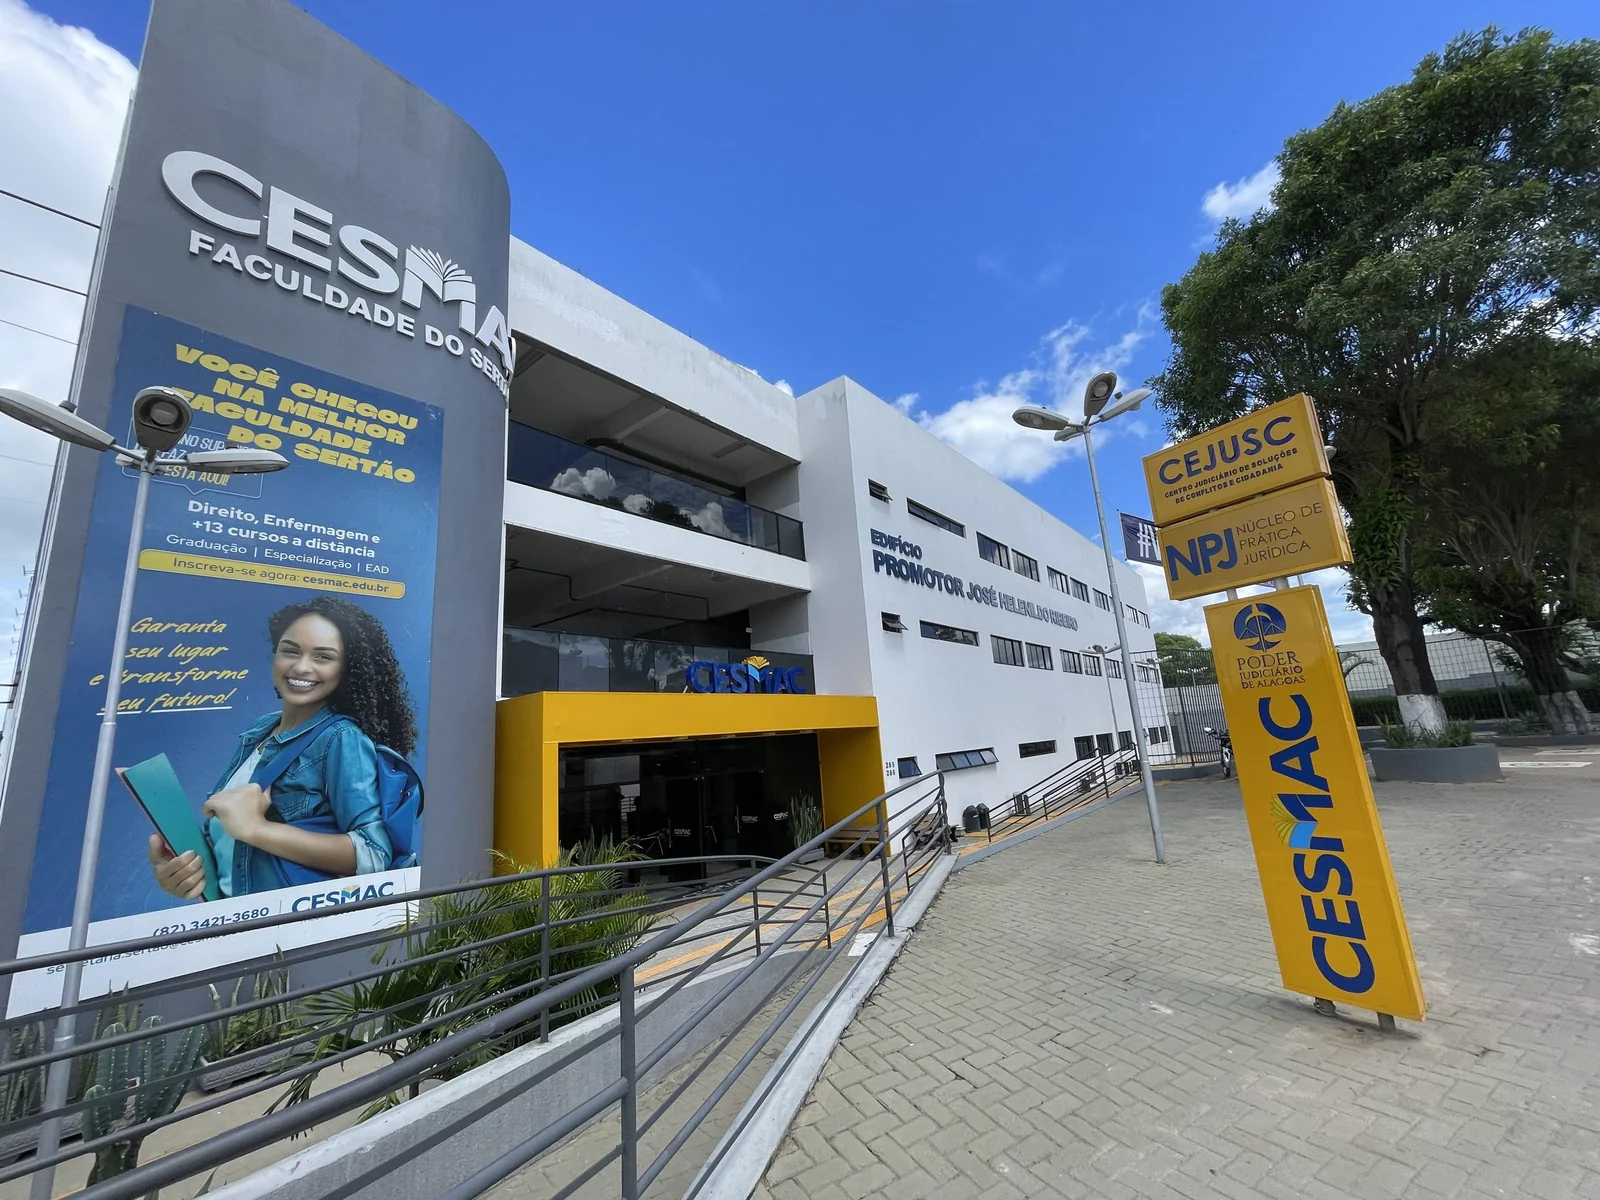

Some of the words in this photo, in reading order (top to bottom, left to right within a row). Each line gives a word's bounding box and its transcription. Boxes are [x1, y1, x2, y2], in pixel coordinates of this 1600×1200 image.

[162, 150, 516, 374] CESMA
[189, 230, 415, 337] FACULDADE
[425, 324, 465, 357] DO
[175, 343, 280, 388] VOCÊ
[290, 382, 418, 429] CHEGOU
[213, 377, 265, 405] NA
[278, 397, 406, 445] MELHOR
[227, 426, 282, 449] DO
[293, 442, 415, 483] SERTÃO
[1159, 416, 1295, 485] CEJUSC
[1165, 484, 1193, 498] CENTRO
[1194, 468, 1238, 488] JUDICIÁRIO
[1239, 465, 1250, 473] DE
[1251, 447, 1298, 468] SOLUÇÕES
[1176, 496, 1185, 504] DE
[1186, 481, 1228, 500] CONFLITOS
[1236, 463, 1283, 484] CIDADANIA
[188, 500, 259, 525] Direito,
[263, 514, 368, 542] Enfermagem
[371, 534, 381, 544] e
[1236, 510, 1296, 535] NÚCLEO
[1300, 502, 1323, 518] DE
[166, 534, 247, 555] Graduação
[264, 548, 352, 570] Especialização
[366, 564, 389, 574] EAD
[192, 520, 223, 534] +13
[228, 527, 289, 545] cursos
[292, 536, 301, 546] a
[305, 537, 375, 558] distância
[870, 528, 922, 560] EDIFÍCIO
[1165, 528, 1238, 581] NPJ
[1239, 526, 1301, 550] PRÁTICA
[1244, 540, 1311, 565] JURÍDICA
[173, 557, 256, 577] Inscreva-se
[260, 569, 300, 584] agora:
[303, 574, 389, 593] cesmac.edu.br
[872, 549, 965, 598] PROMOTOR
[967, 582, 998, 608] JOSÉ
[998, 592, 1050, 622] HELENILDO
[1049, 609, 1079, 631] RIBEIRO
[131, 617, 227, 633] Garanta
[125, 647, 163, 658] seu
[168, 643, 229, 665] lugar
[1237, 651, 1301, 670] PODER
[89, 674, 104, 686] e
[121, 667, 249, 686] ransforme
[686, 656, 808, 693] CESMAC
[1240, 665, 1303, 681] JUDICIÁRIO
[1241, 681, 1255, 689] DE
[1257, 675, 1306, 688] ALAGOAS
[101, 697, 145, 711] eu
[145, 688, 237, 713] futuro!
[1258, 694, 1376, 993] CESMAC
[190, 907, 269, 931] 3421-3680
